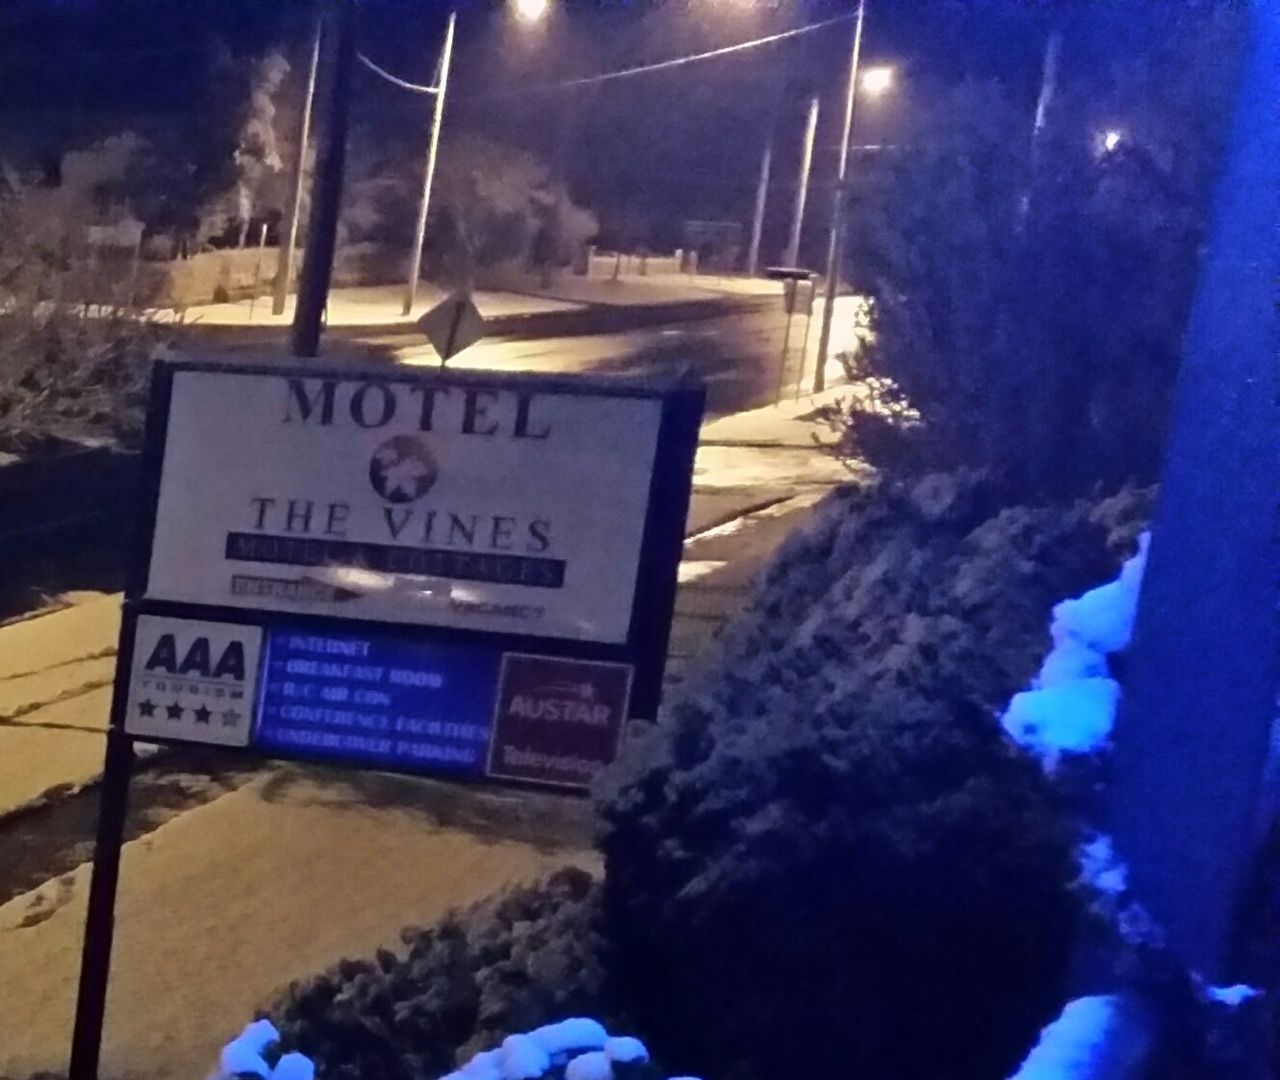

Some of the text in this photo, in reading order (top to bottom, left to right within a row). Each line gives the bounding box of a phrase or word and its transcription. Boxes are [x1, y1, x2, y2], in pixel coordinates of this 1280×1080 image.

[283, 377, 552, 439] MOTEL
[250, 498, 554, 552] THE VINES
[144, 632, 246, 682] AAA
[288, 636, 371, 657] INTERNET
[286, 658, 385, 682] BREAKFAST
[508, 695, 612, 727] AUSTAR
